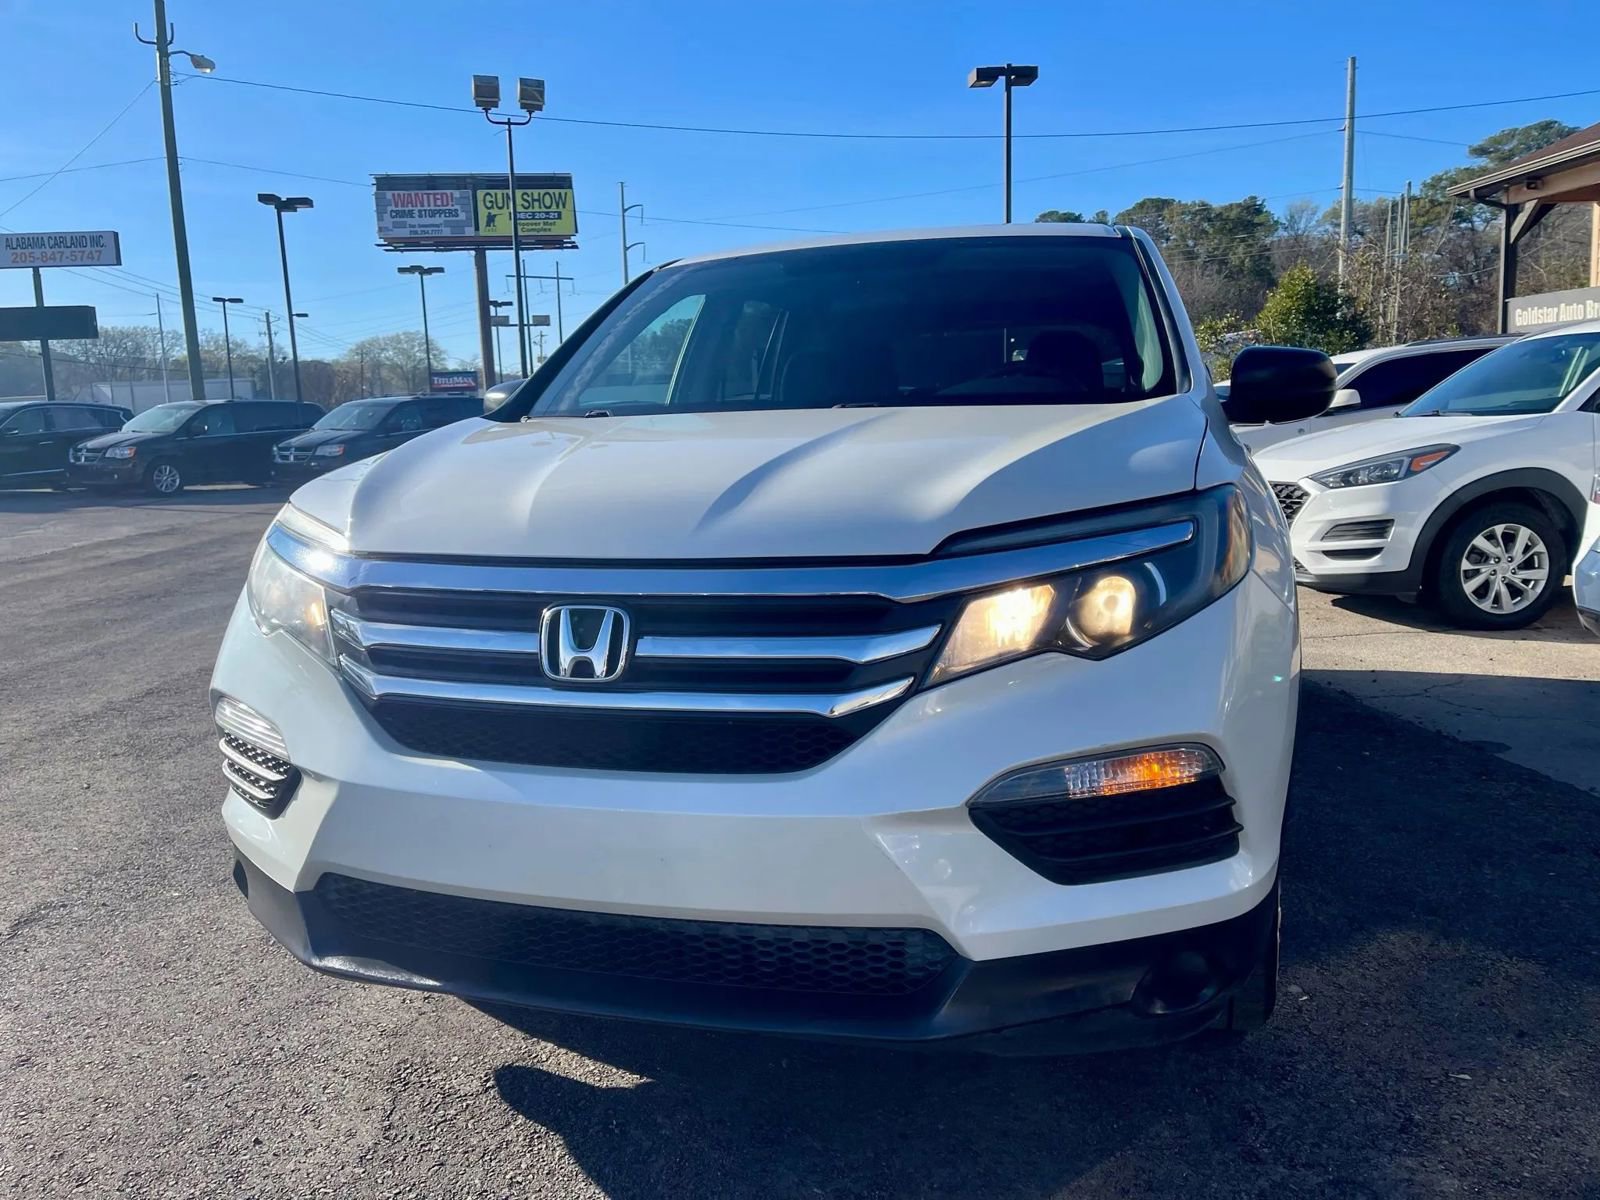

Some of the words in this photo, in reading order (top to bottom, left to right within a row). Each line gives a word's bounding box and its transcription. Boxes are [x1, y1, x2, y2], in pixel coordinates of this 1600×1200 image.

[391, 191, 455, 208] WANTED!
[520, 191, 567, 210] SHOW
[389, 209, 416, 219] CRIME
[417, 208, 459, 218] STOPPERS
[5, 236, 46, 250] ALABAMA
[47, 234, 88, 249] CARLAND
[89, 234, 107, 248] INC.
[11, 249, 103, 264] 205-847-5747
[1515, 306, 1559, 326] Goldstar
[1559, 303, 1585, 321] Auto
